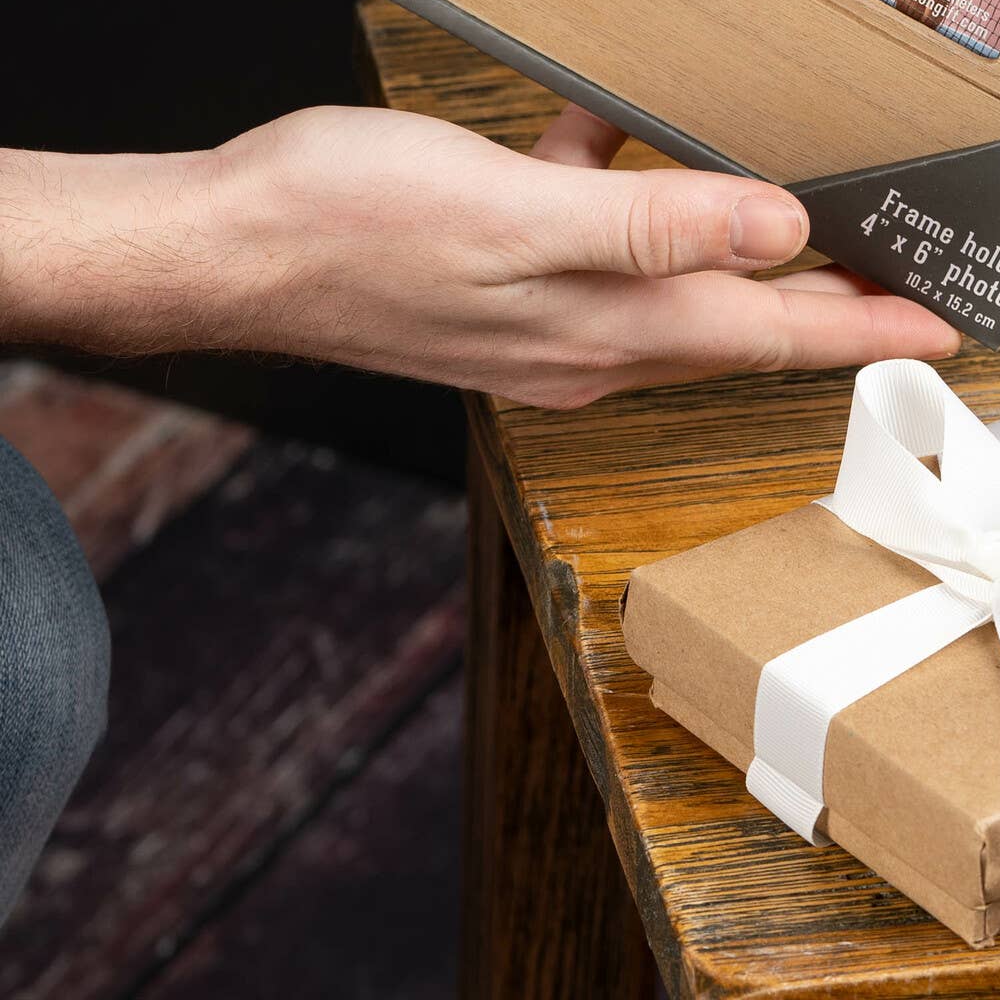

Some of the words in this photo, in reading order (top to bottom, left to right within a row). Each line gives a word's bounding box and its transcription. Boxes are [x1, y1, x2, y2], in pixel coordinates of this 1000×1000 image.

[880, 188, 954, 244] Frame
[890, 234, 908, 254] x
[905, 271, 932, 295] 10.2
[933, 290, 943, 302] x
[946, 293, 973, 318] 15.2
[974, 312, 996, 330] cm
